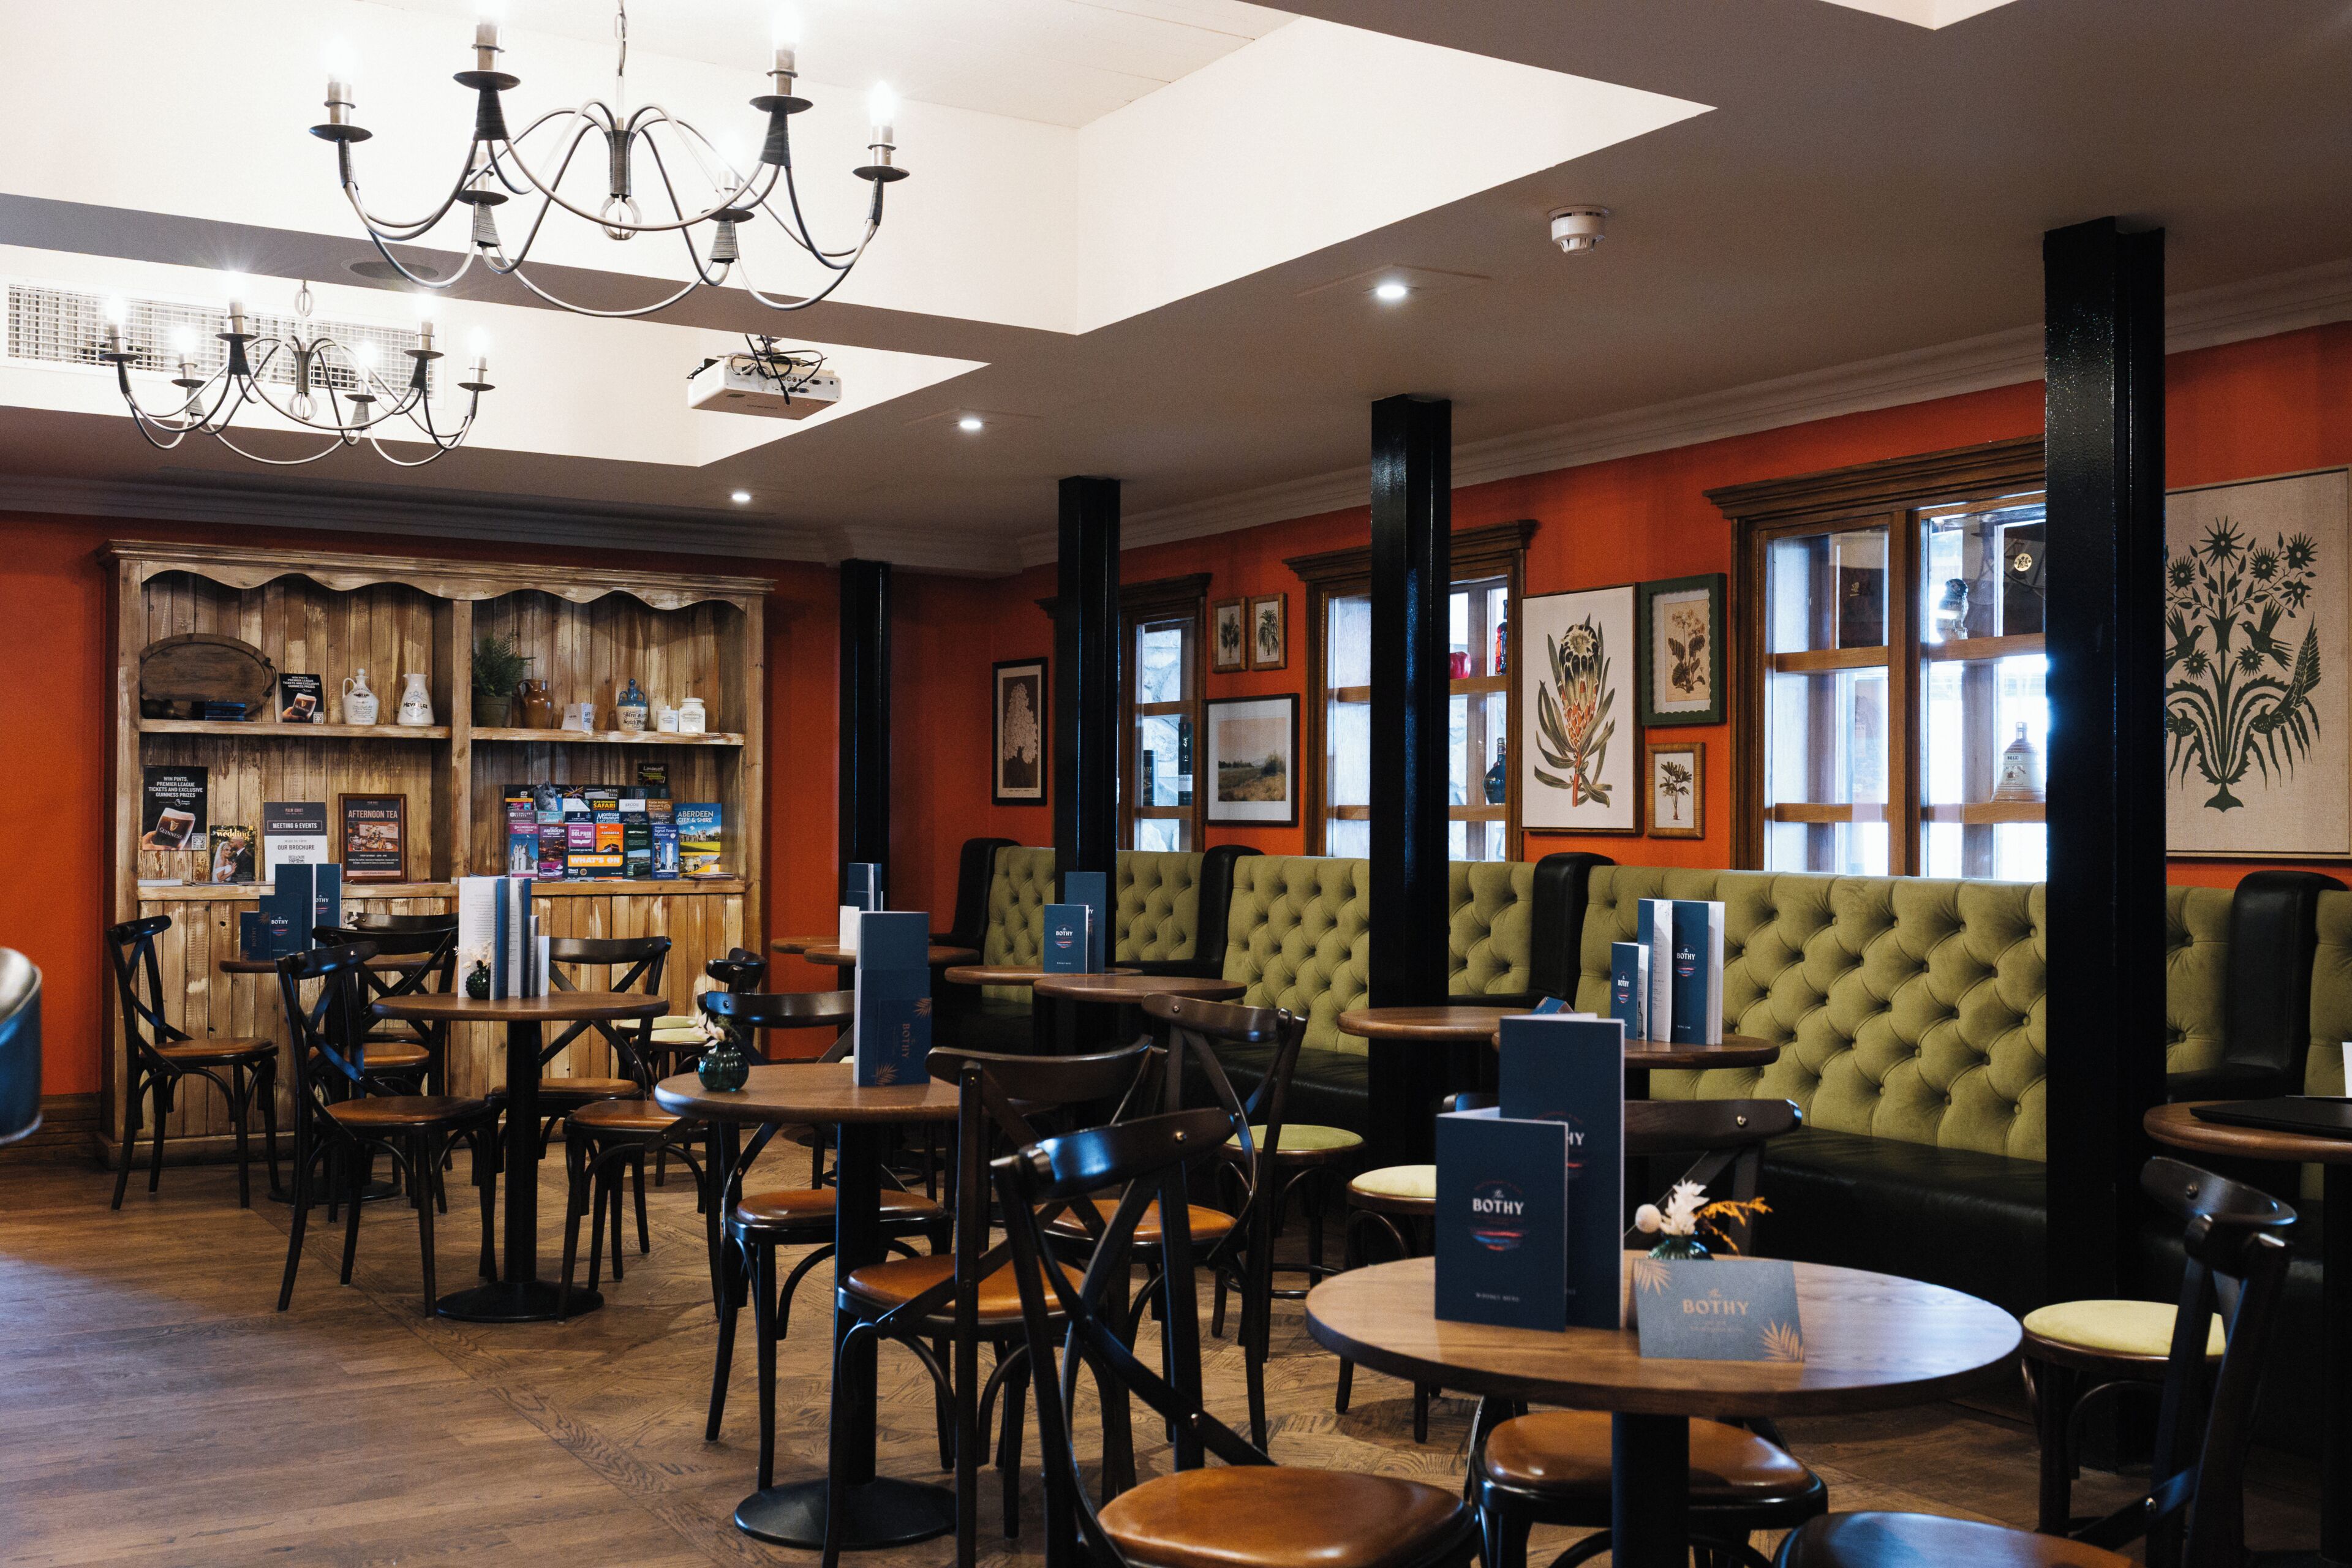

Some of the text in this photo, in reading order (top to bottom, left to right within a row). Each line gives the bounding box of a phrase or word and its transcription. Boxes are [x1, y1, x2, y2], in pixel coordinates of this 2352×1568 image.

[159, 827, 182, 839] GUINNESS
[216, 828, 249, 841] wedding
[902, 1024, 910, 1058] BOTHY
[1473, 1198, 1524, 1215] BOTHY
[1682, 1299, 1749, 1316] BOTHY
